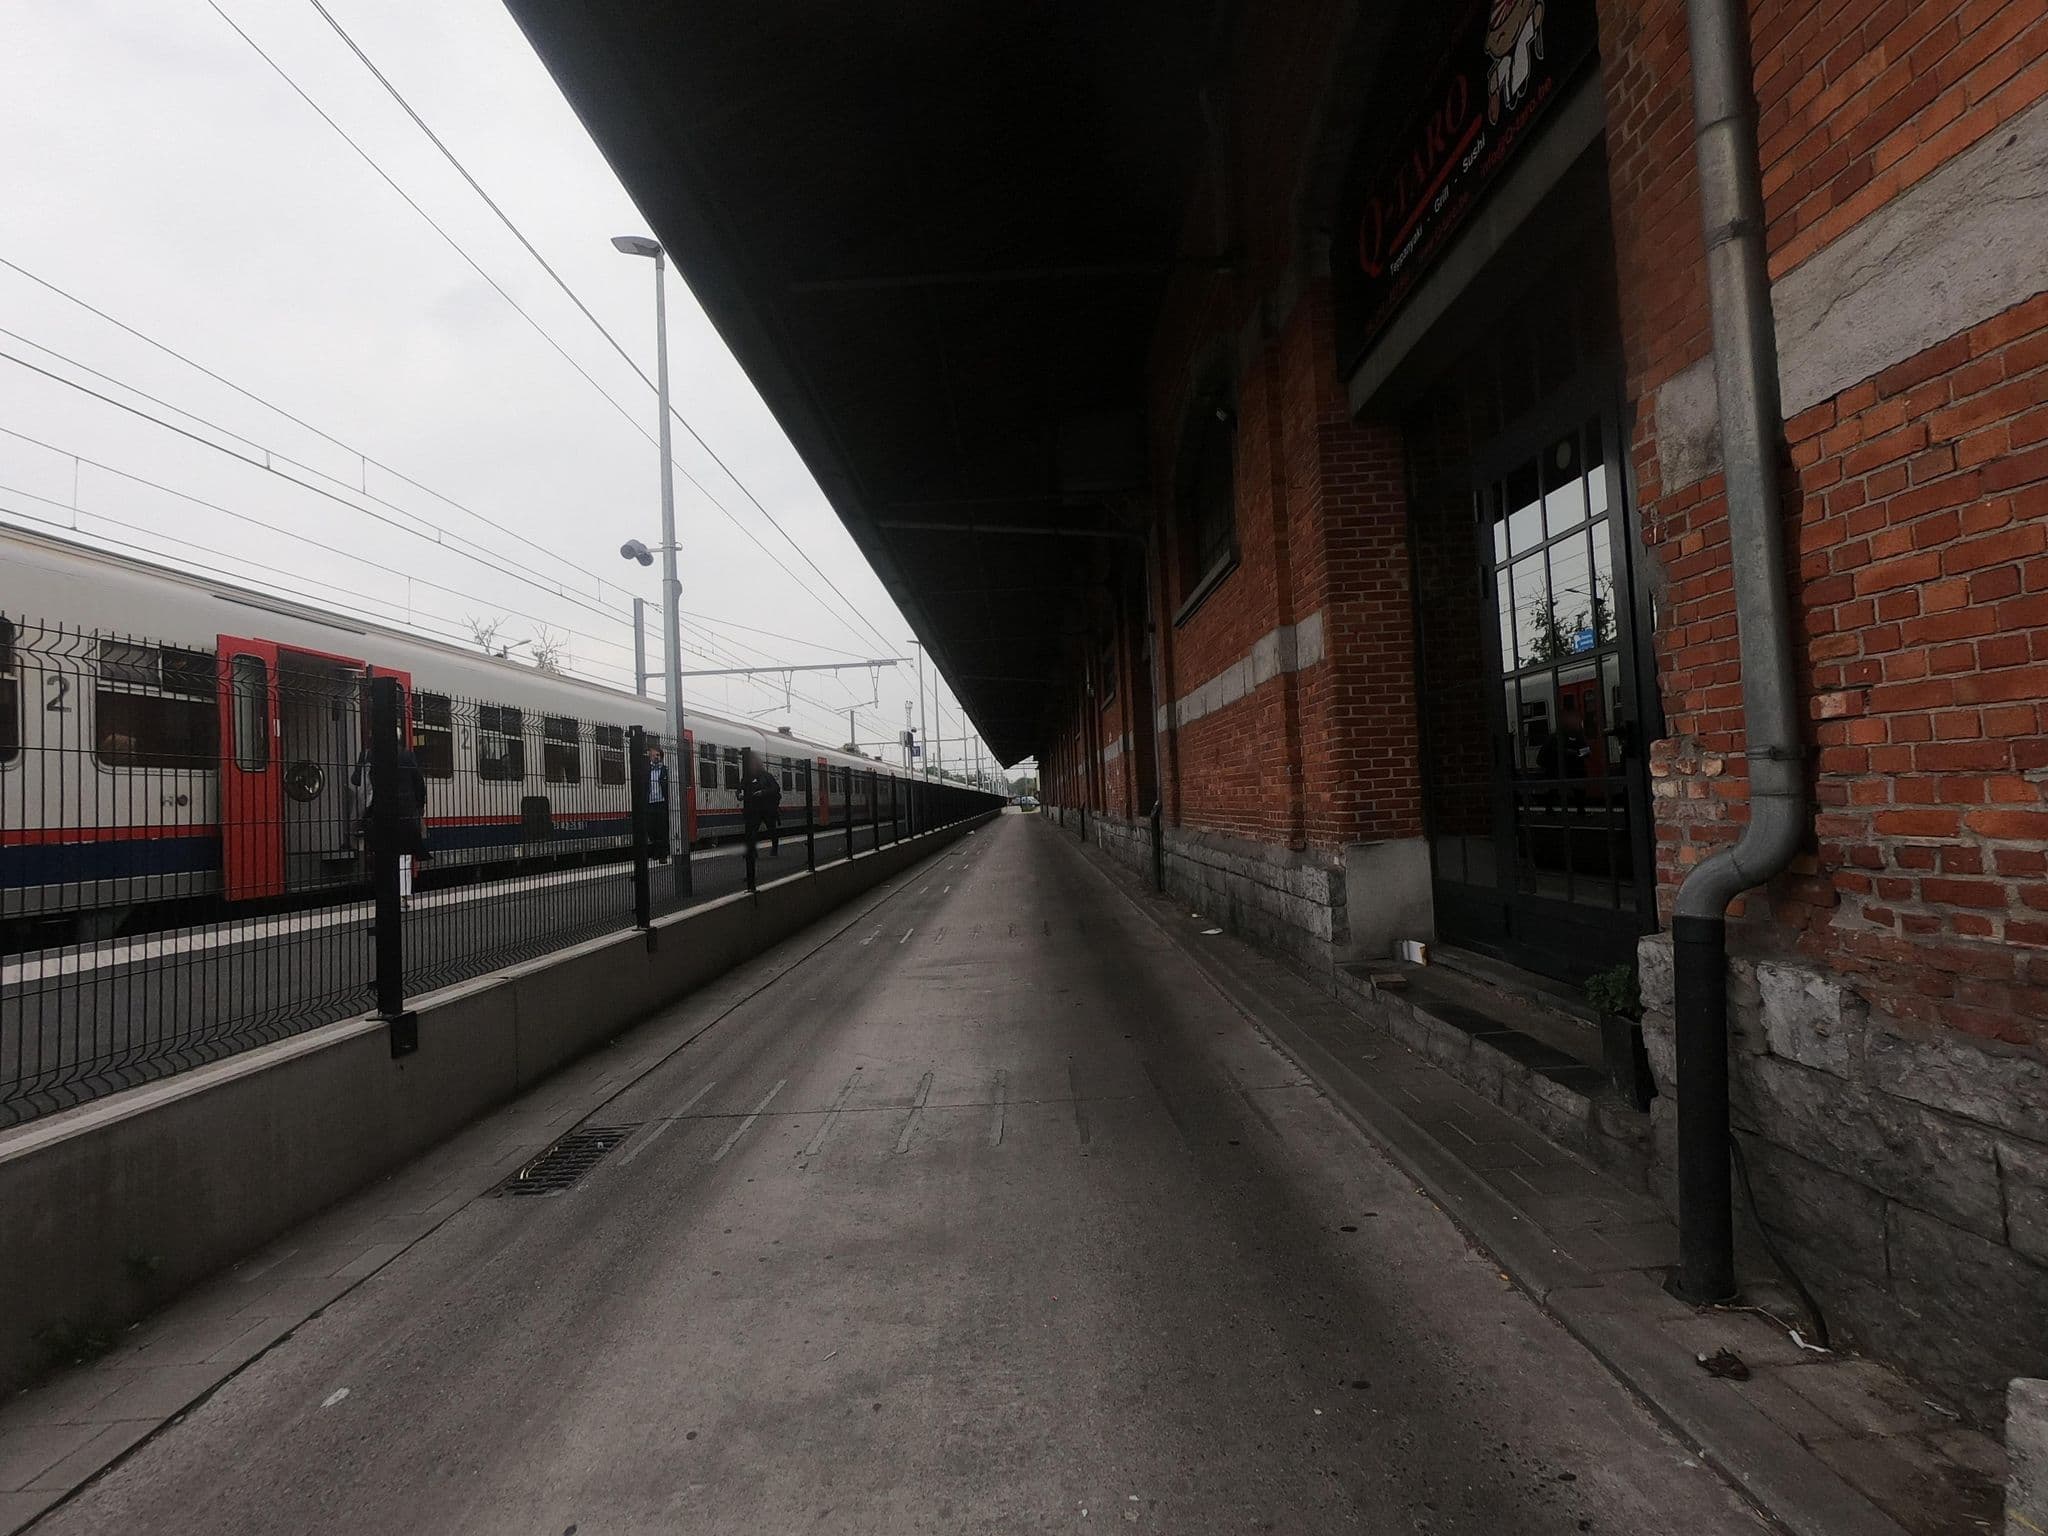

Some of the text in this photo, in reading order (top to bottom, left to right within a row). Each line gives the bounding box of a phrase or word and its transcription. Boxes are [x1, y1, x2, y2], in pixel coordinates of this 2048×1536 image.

[1434, 186, 1450, 213] Grill
[1461, 132, 1487, 174] Sushi
[46, 674, 73, 713] 2
[461, 728, 472, 751] 2
